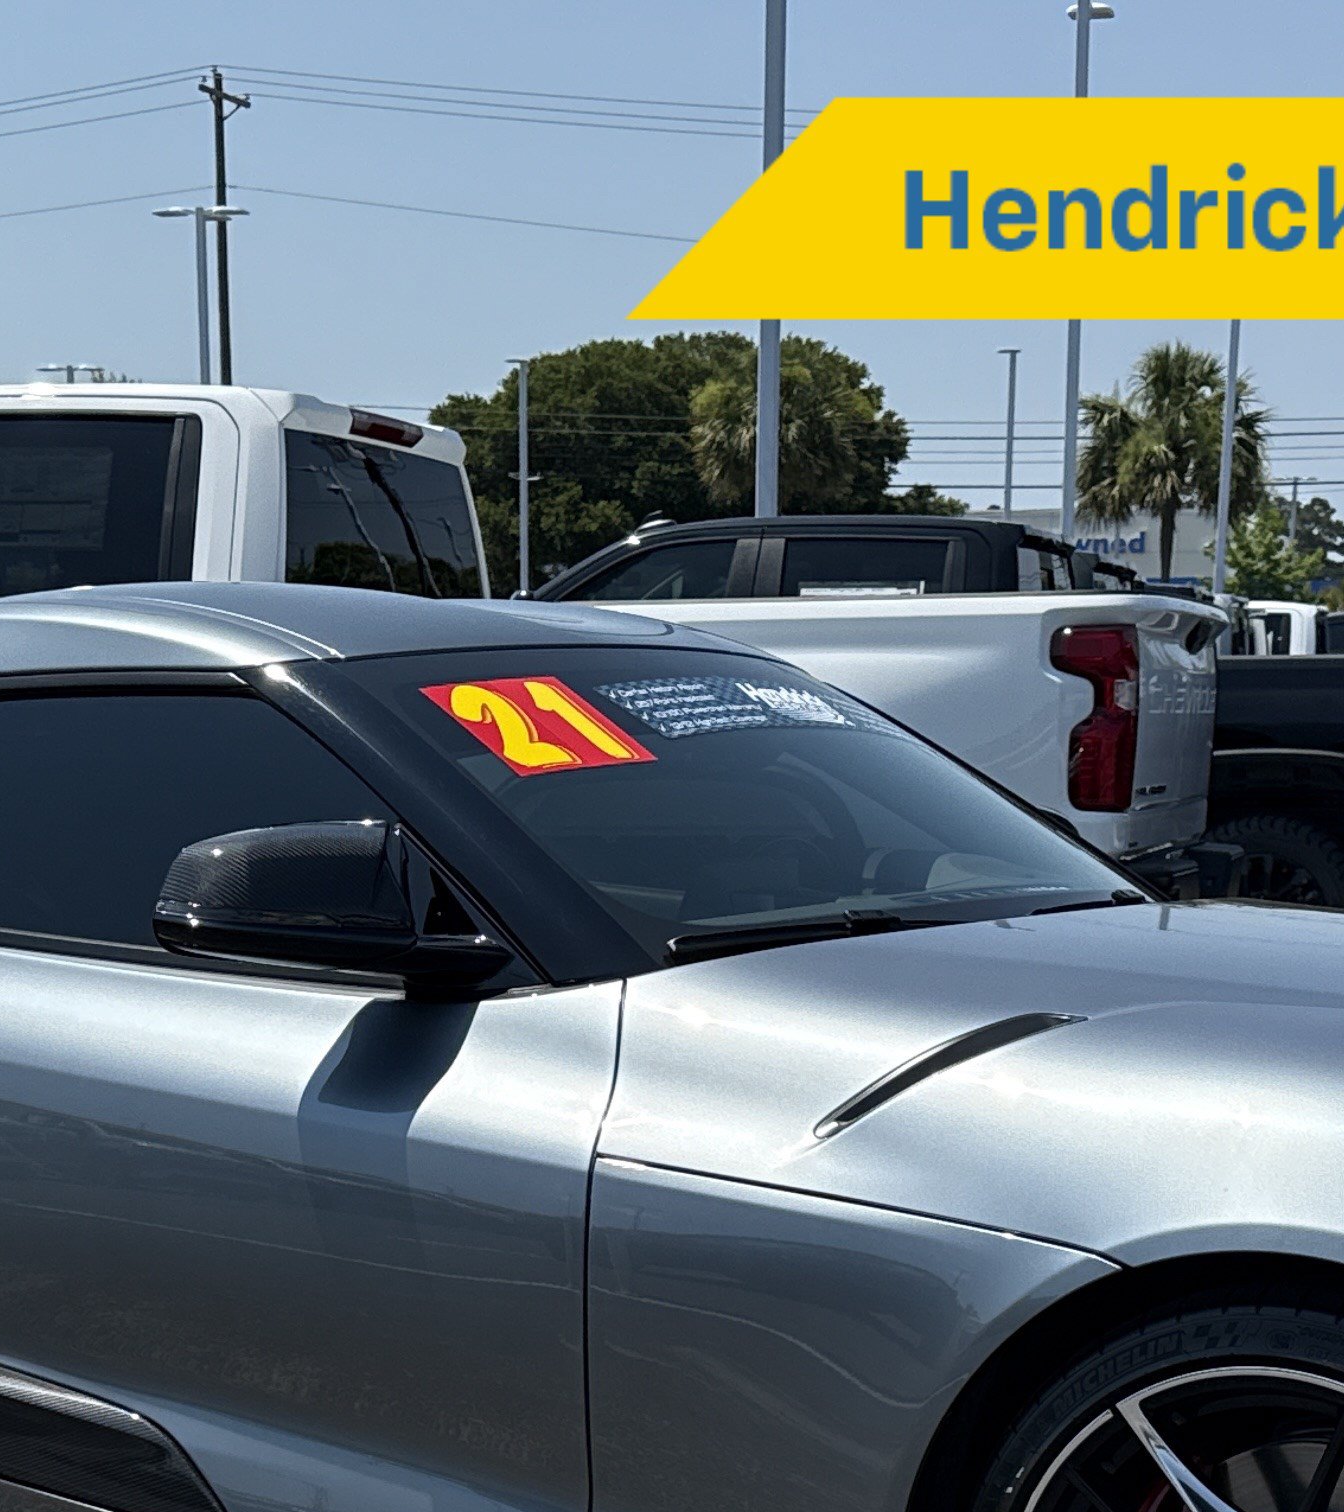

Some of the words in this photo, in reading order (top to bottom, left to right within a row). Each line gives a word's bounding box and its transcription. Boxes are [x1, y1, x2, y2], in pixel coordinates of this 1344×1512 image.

[1076, 531, 1146, 554] wned
[450, 680, 641, 769] 21
[735, 682, 840, 716] Hendrick
[1052, 1329, 1184, 1416] MICHELIN
